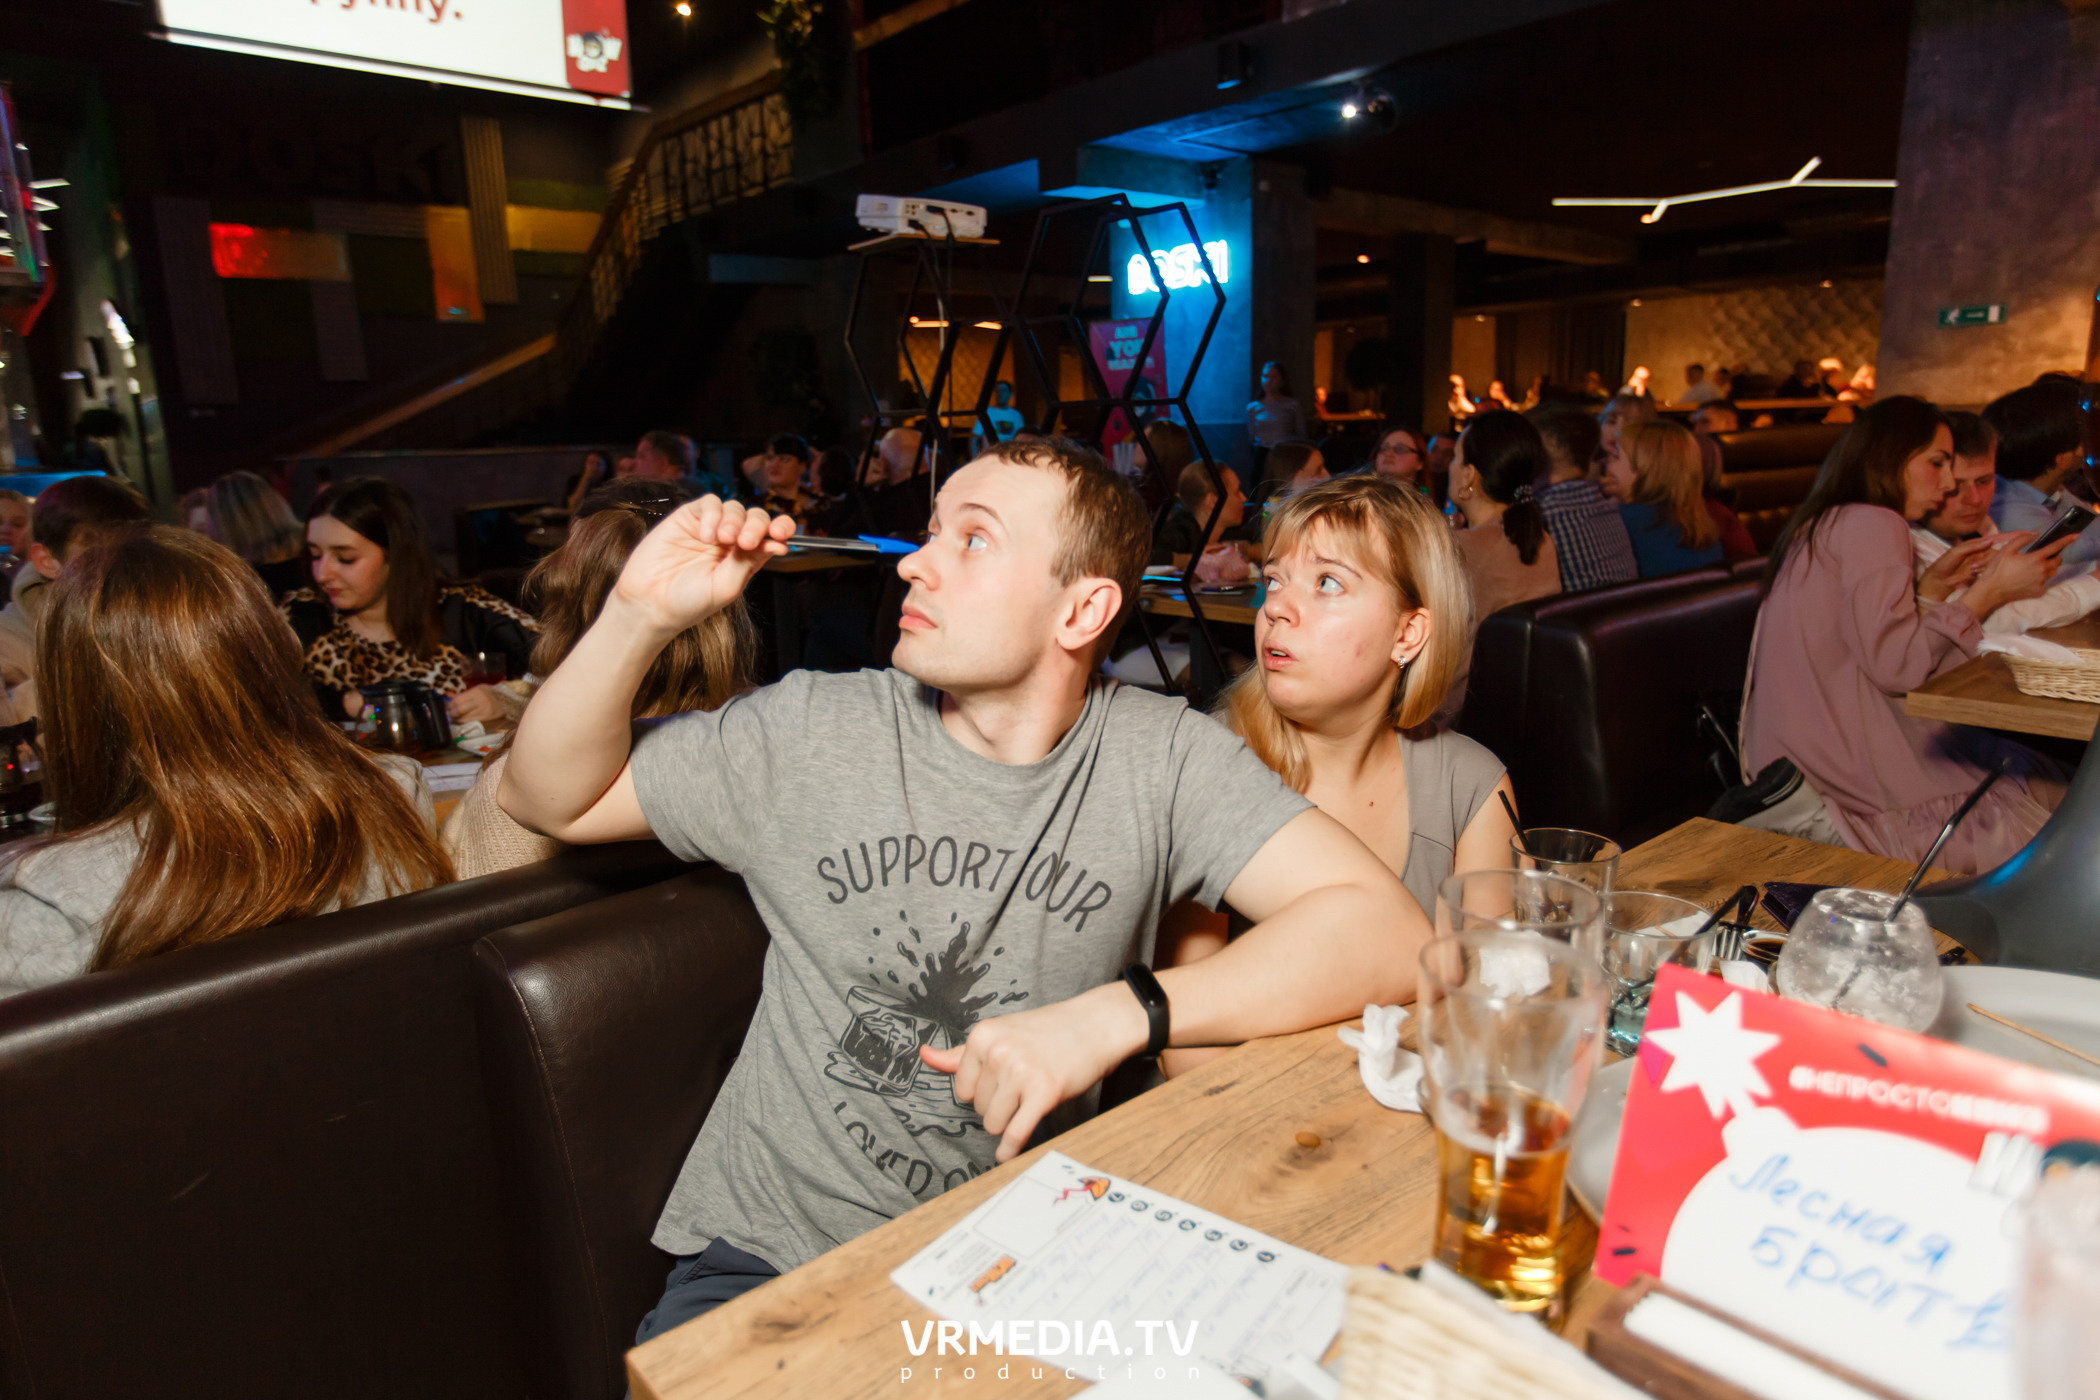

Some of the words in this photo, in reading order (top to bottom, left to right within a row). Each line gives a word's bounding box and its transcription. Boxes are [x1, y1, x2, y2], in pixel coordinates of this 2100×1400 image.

[817, 834, 1018, 904] SUPPORT
[1025, 851, 1112, 932] OUR
[1728, 1152, 1954, 1276] Лесная
